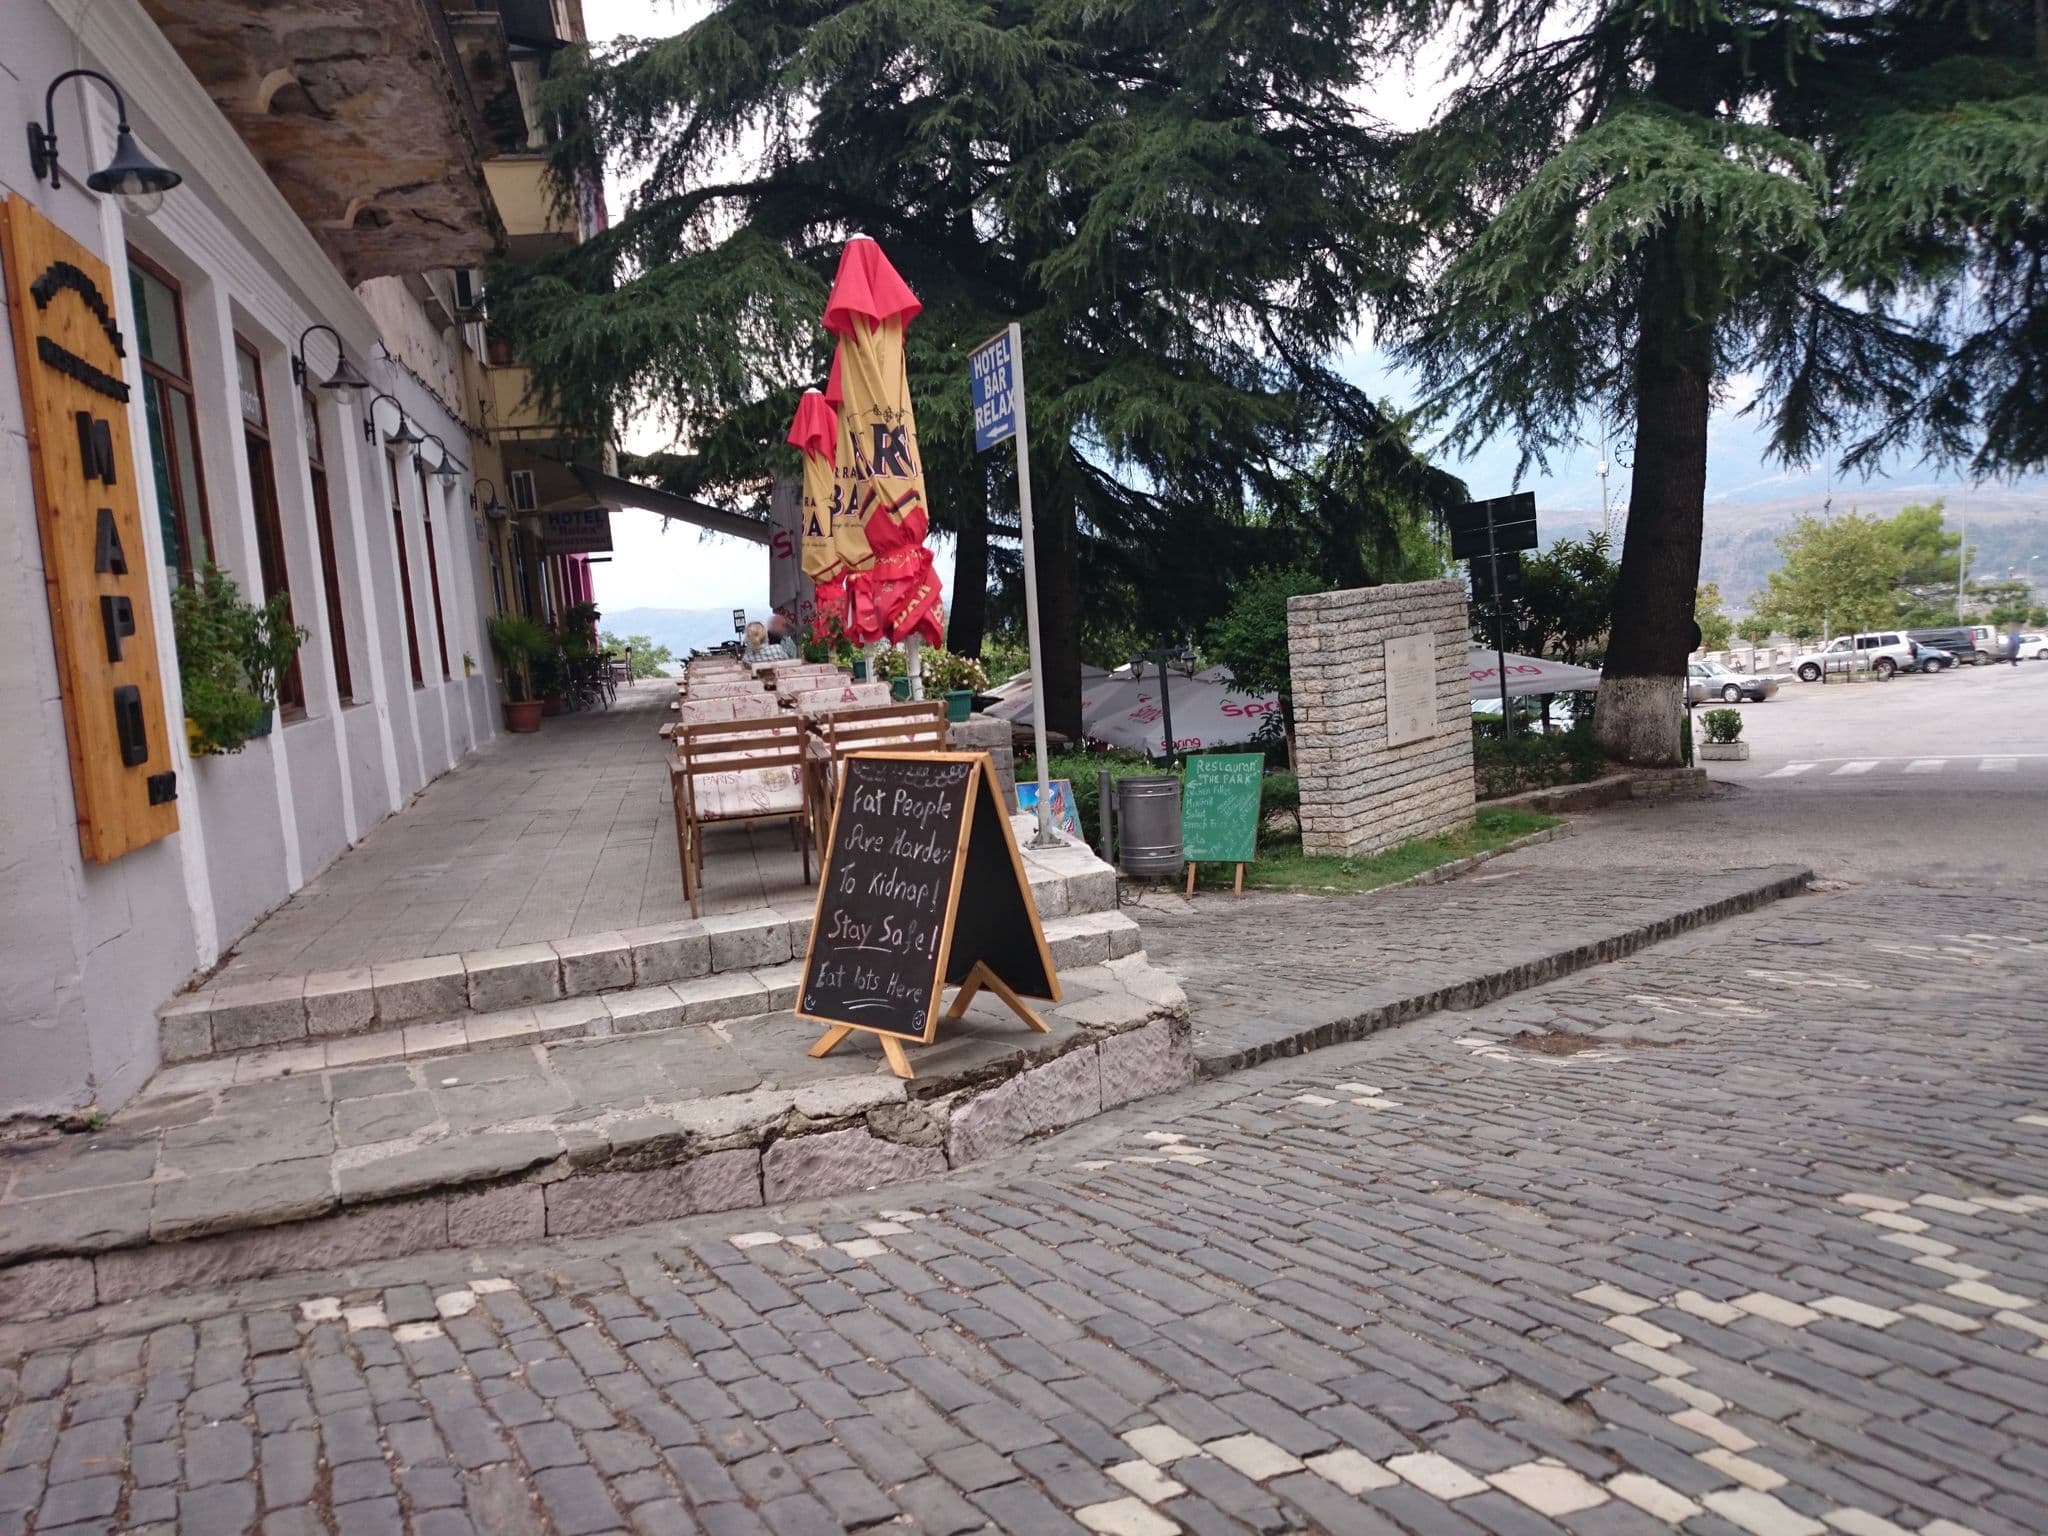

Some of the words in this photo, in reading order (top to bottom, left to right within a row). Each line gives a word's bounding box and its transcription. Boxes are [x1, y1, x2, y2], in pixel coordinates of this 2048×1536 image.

[973, 338, 1010, 379] HOTEL
[984, 366, 1007, 400] BAR
[975, 389, 1016, 431] RELAX
[548, 511, 604, 525] HOTEL
[703, 775, 736, 786] PARIS
[852, 785, 886, 816] Fat
[891, 789, 951, 829] People
[845, 824, 883, 851] Are
[889, 828, 951, 864] Harder
[839, 863, 856, 894] To
[868, 867, 940, 913] Kidnap!
[828, 909, 872, 947] Stay
[878, 914, 939, 960] Safe!
[815, 961, 846, 990] Eat
[886, 971, 924, 1003] Here
